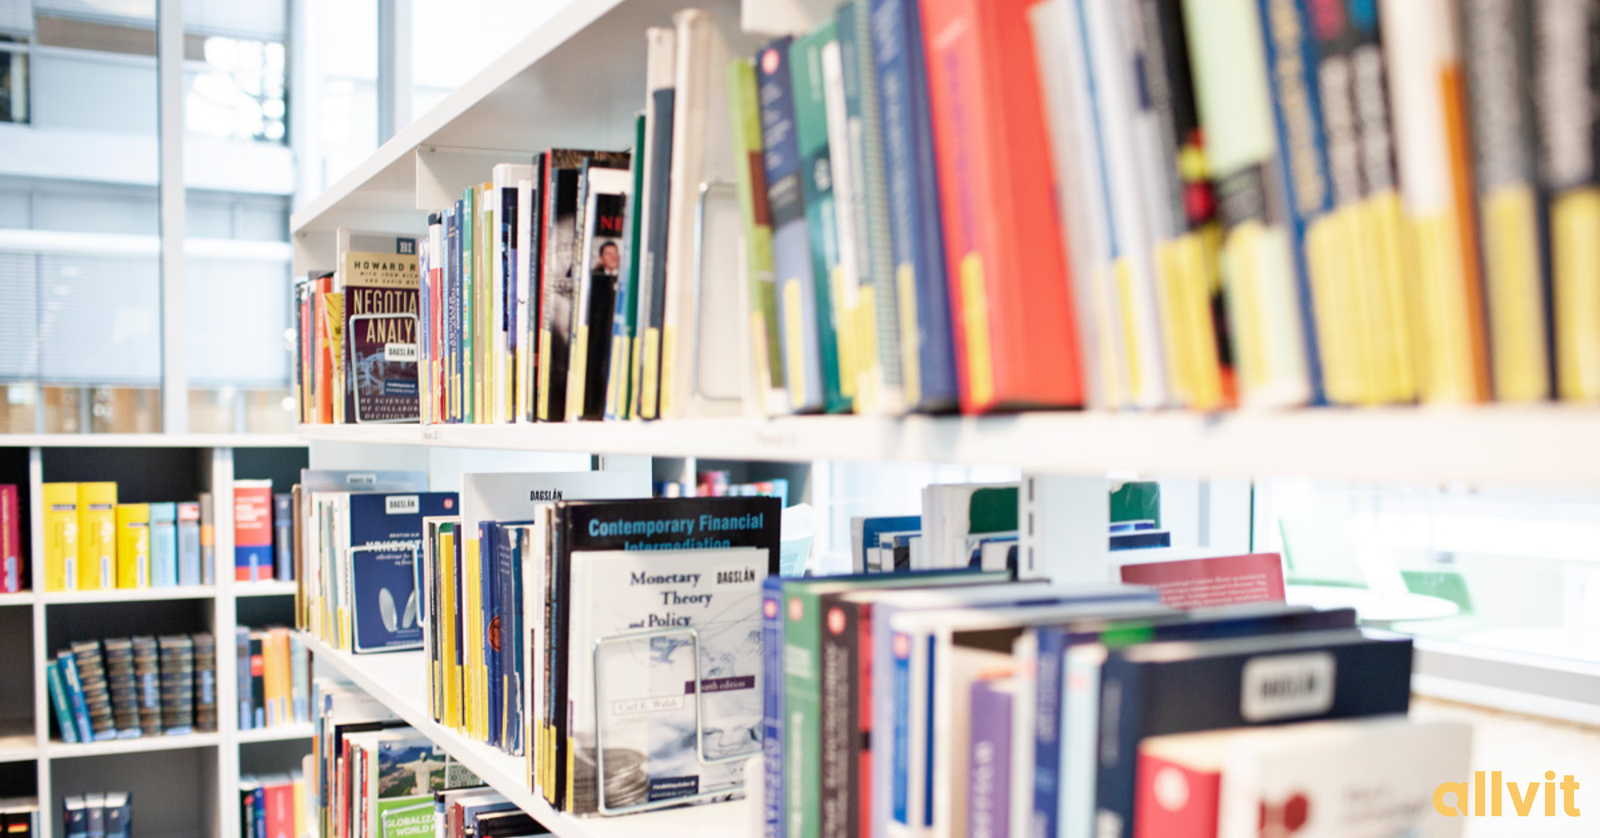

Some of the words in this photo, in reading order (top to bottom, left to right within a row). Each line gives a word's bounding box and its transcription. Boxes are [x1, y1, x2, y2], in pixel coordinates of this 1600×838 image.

[354, 261, 404, 271] HOWARD
[353, 289, 418, 316] NEGOTIA
[366, 318, 416, 344] ANALY
[388, 347, 415, 356] DAGSLÅN
[375, 397, 410, 405] SCIENCE
[529, 488, 563, 501] DAGSLÅN
[389, 498, 415, 509] DAGSLÅN
[588, 519, 695, 537] Contemporary
[699, 512, 764, 532] Financial
[624, 537, 731, 552] Intermediation
[630, 572, 701, 588] Monetary
[717, 567, 756, 584] DAGSLÅN
[660, 591, 713, 608] Theory
[628, 619, 645, 629] and
[647, 612, 692, 628] Policy
[719, 679, 746, 690] edition
[618, 700, 639, 712] Carl
[651, 696, 680, 709] Walsh
[396, 824, 430, 837] WORLD
